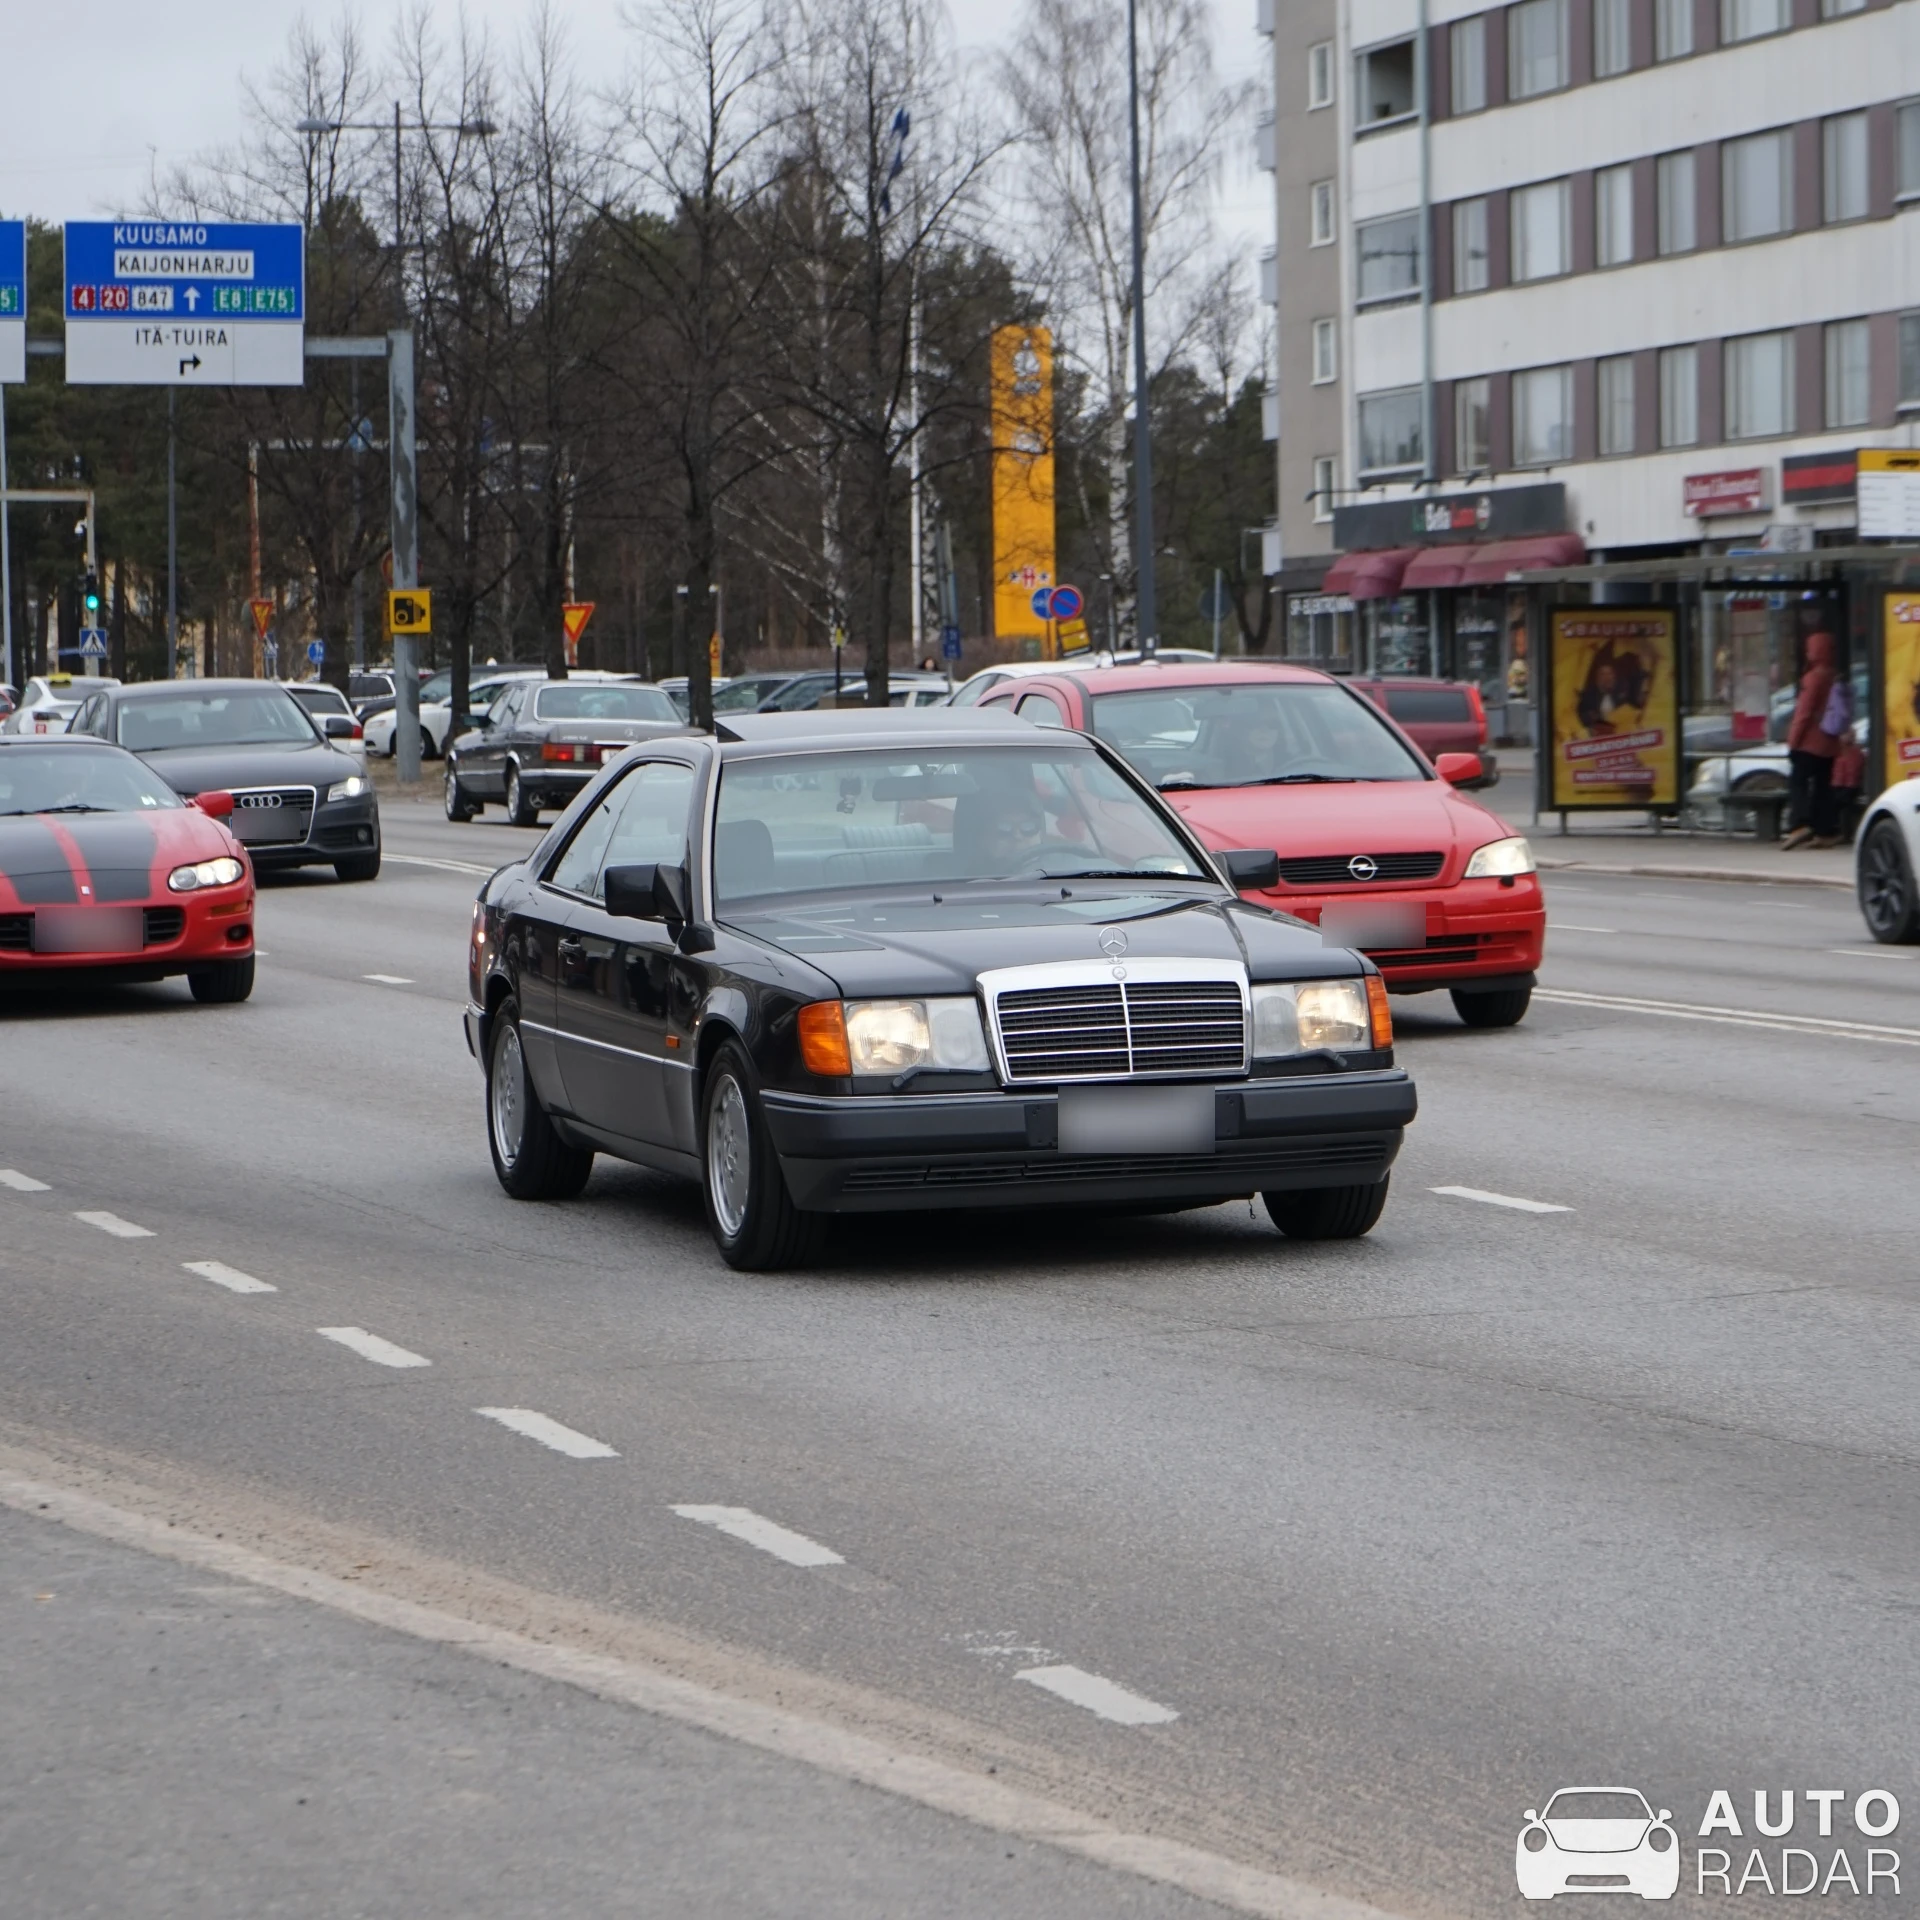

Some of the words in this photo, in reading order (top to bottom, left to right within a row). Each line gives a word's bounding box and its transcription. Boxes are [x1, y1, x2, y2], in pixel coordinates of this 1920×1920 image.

[114, 225, 207, 245] KUUSAMO
[119, 255, 248, 273] KAIJONHARJU
[78, 288, 89, 308] 4
[103, 288, 126, 308] 20
[138, 290, 168, 307] 847
[219, 287, 242, 309] E8
[255, 287, 288, 309] E75
[136, 325, 228, 346] ITÄ-TUIRA
